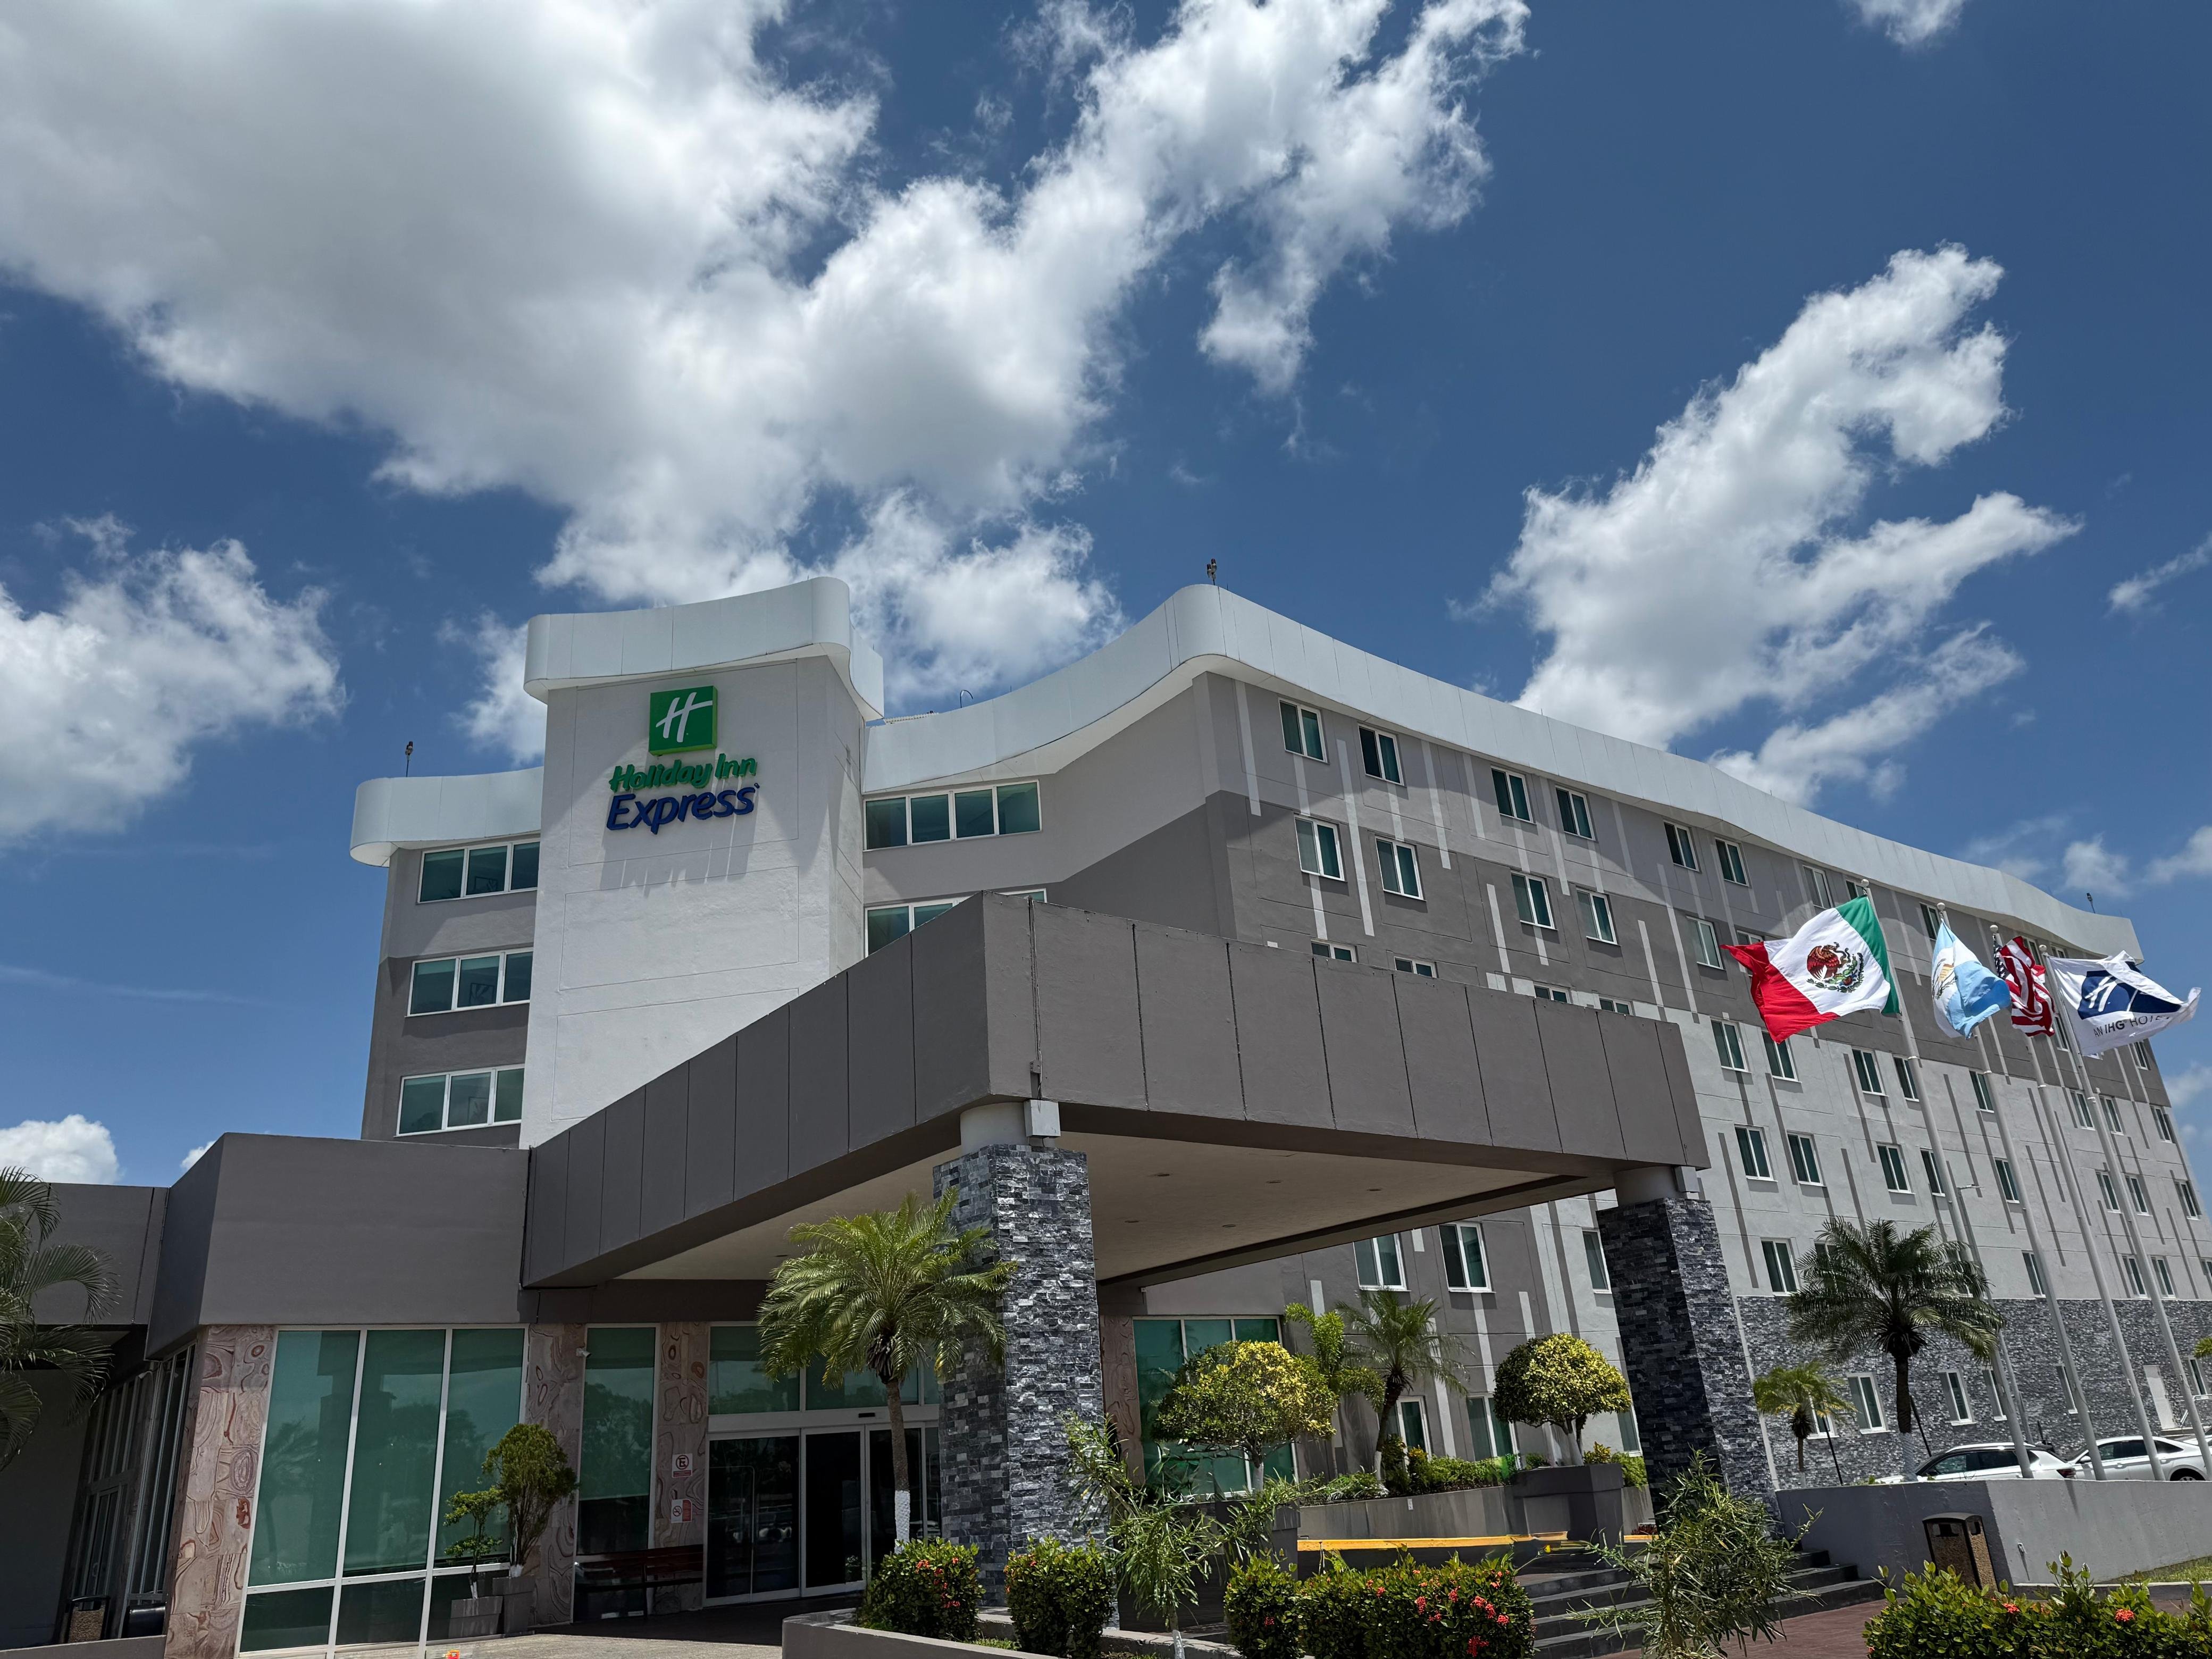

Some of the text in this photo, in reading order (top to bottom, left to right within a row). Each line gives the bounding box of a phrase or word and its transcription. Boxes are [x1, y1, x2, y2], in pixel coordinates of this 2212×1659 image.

[656, 692, 713, 743] H
[608, 753, 757, 792] Holiday Inn
[606, 786, 756, 834] Express
[2093, 1026, 2103, 1037] AN
[2105, 1020, 2125, 1034] IHG
